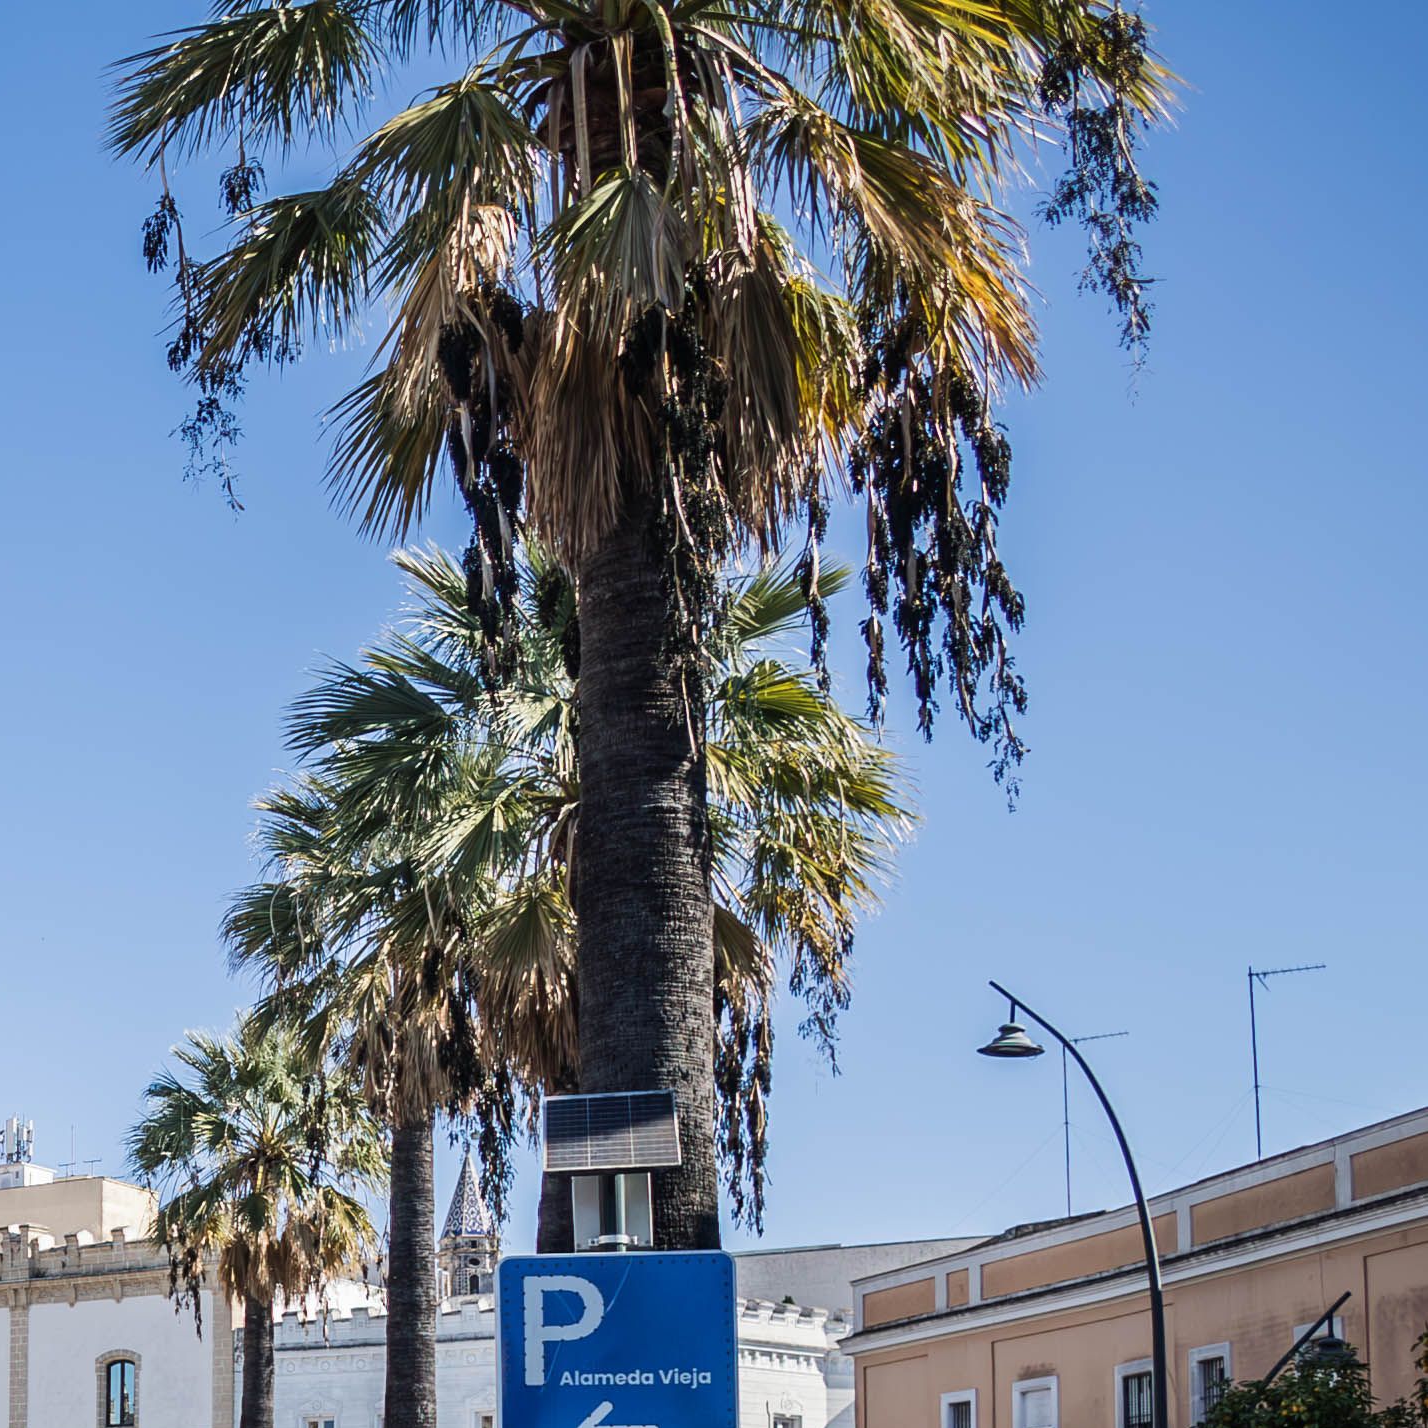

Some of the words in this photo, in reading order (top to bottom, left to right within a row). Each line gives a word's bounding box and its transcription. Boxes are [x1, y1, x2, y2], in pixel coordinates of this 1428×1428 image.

[523, 1275, 604, 1386] P
[559, 1369, 654, 1386] Alameda
[658, 1367, 712, 1389] Vieja
